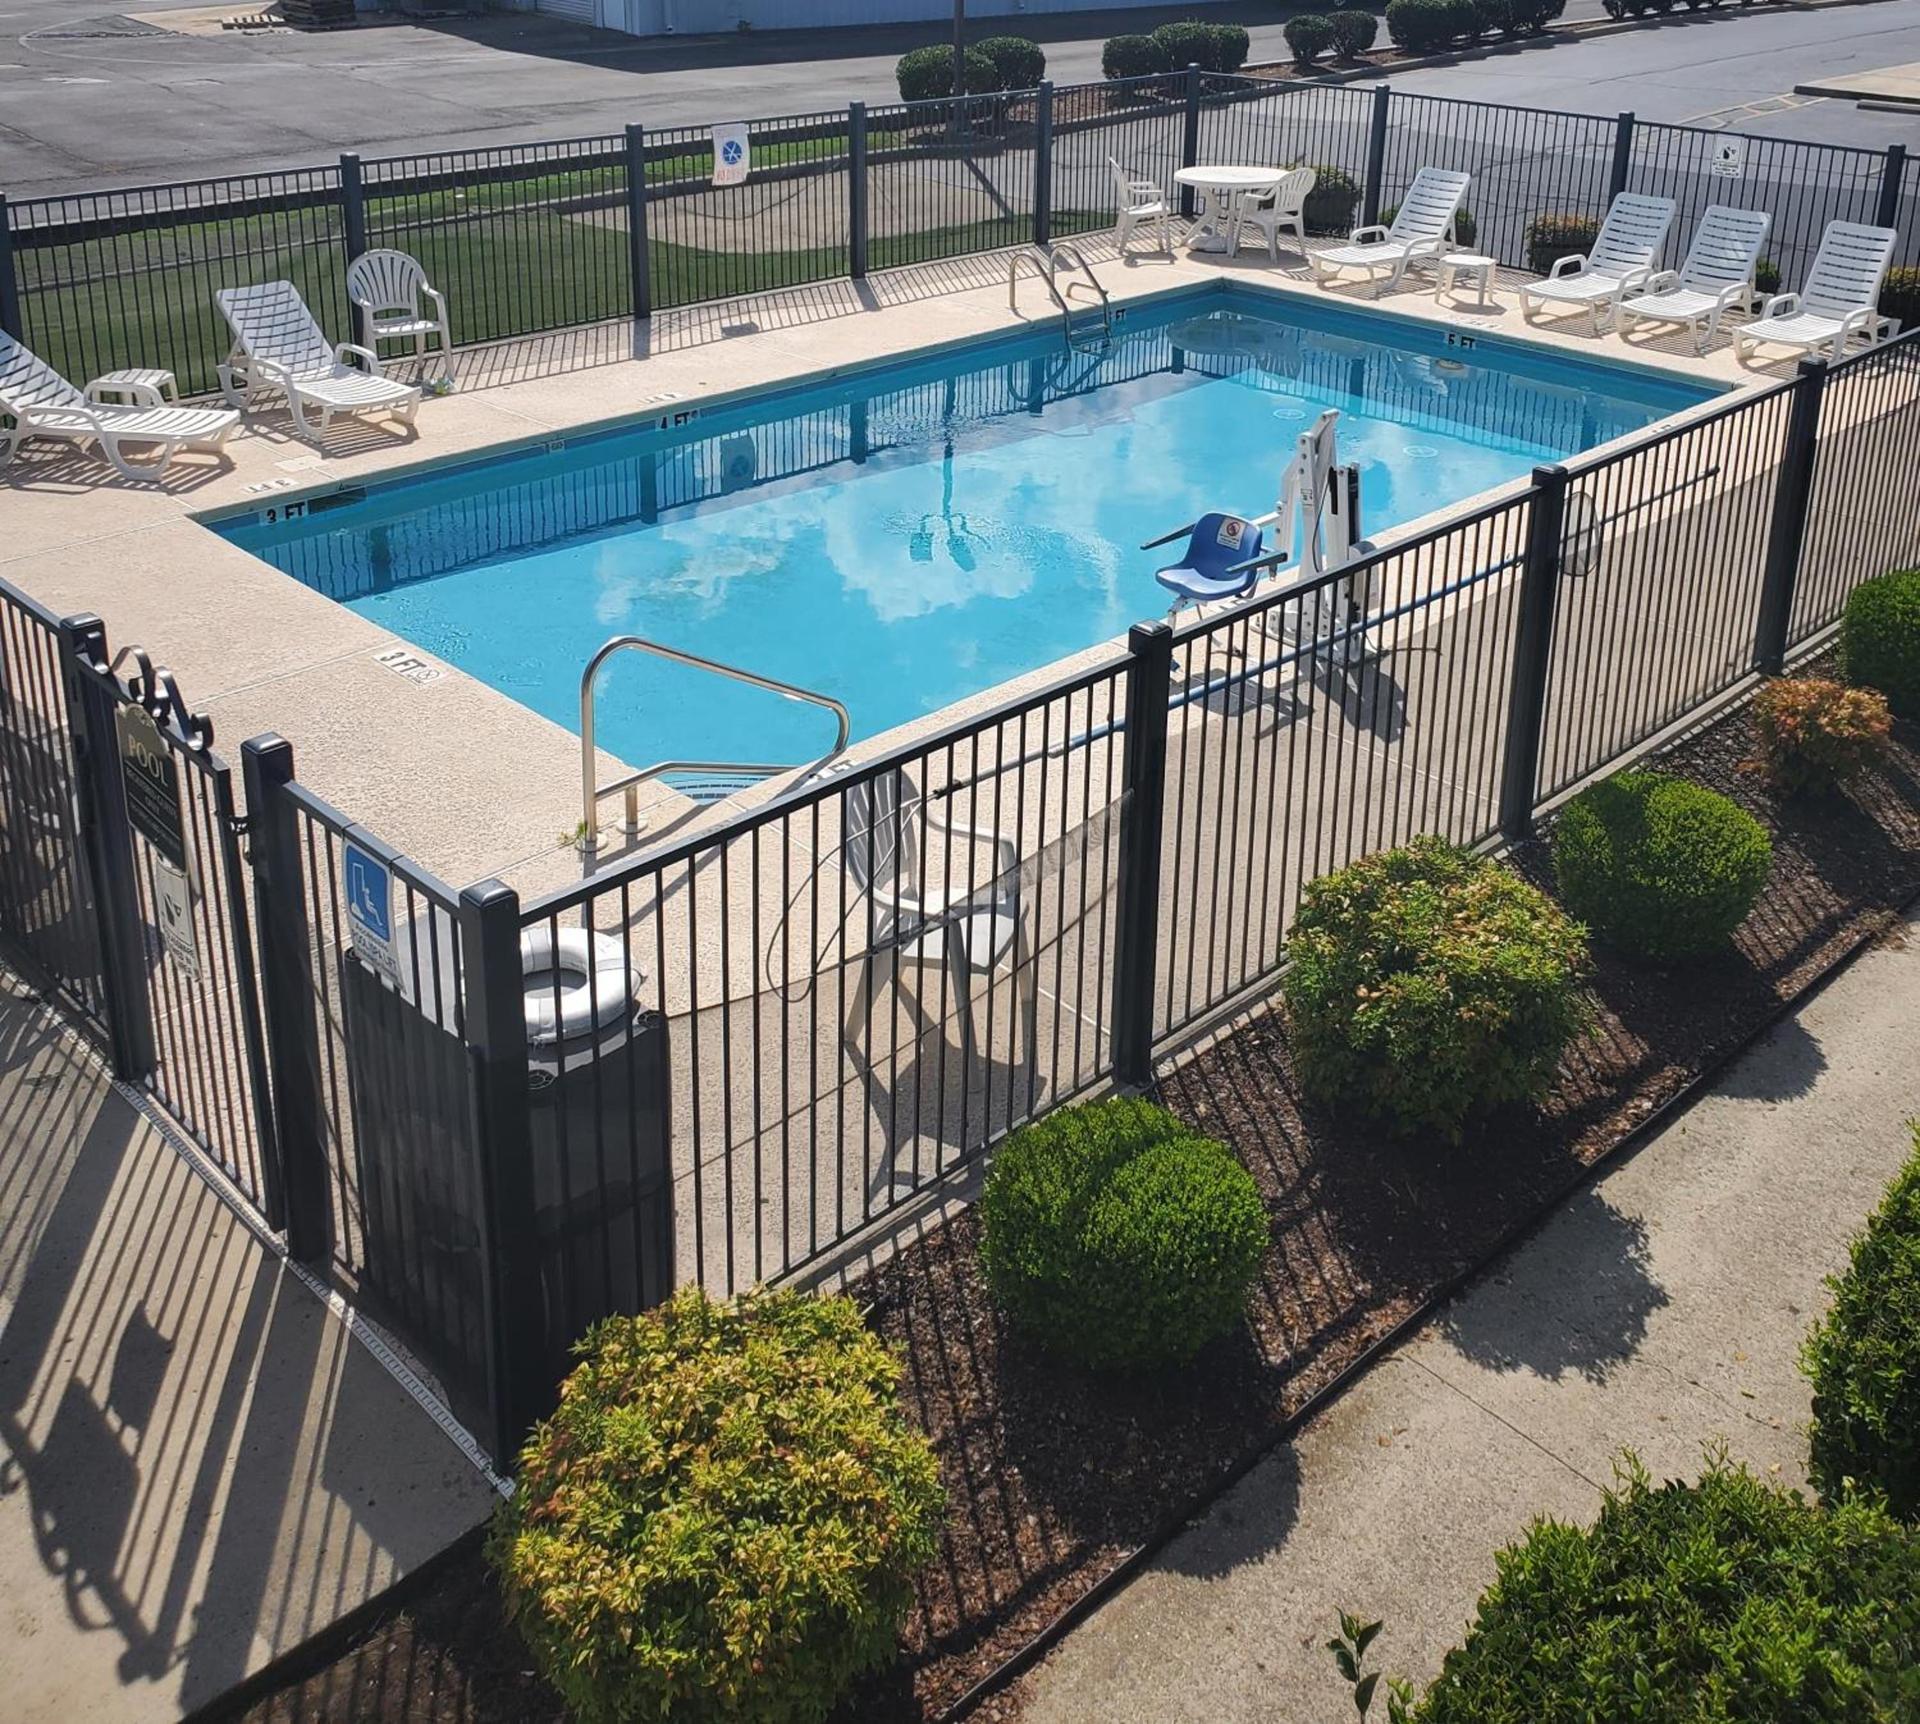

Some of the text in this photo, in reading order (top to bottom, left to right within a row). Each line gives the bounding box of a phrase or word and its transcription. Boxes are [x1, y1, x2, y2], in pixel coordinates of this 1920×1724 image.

[1461, 336, 1475, 349] FT
[674, 412, 690, 427] FT
[267, 501, 305, 523] 3 FT
[391, 658, 427, 673] FT
[128, 733, 169, 787] POOL
